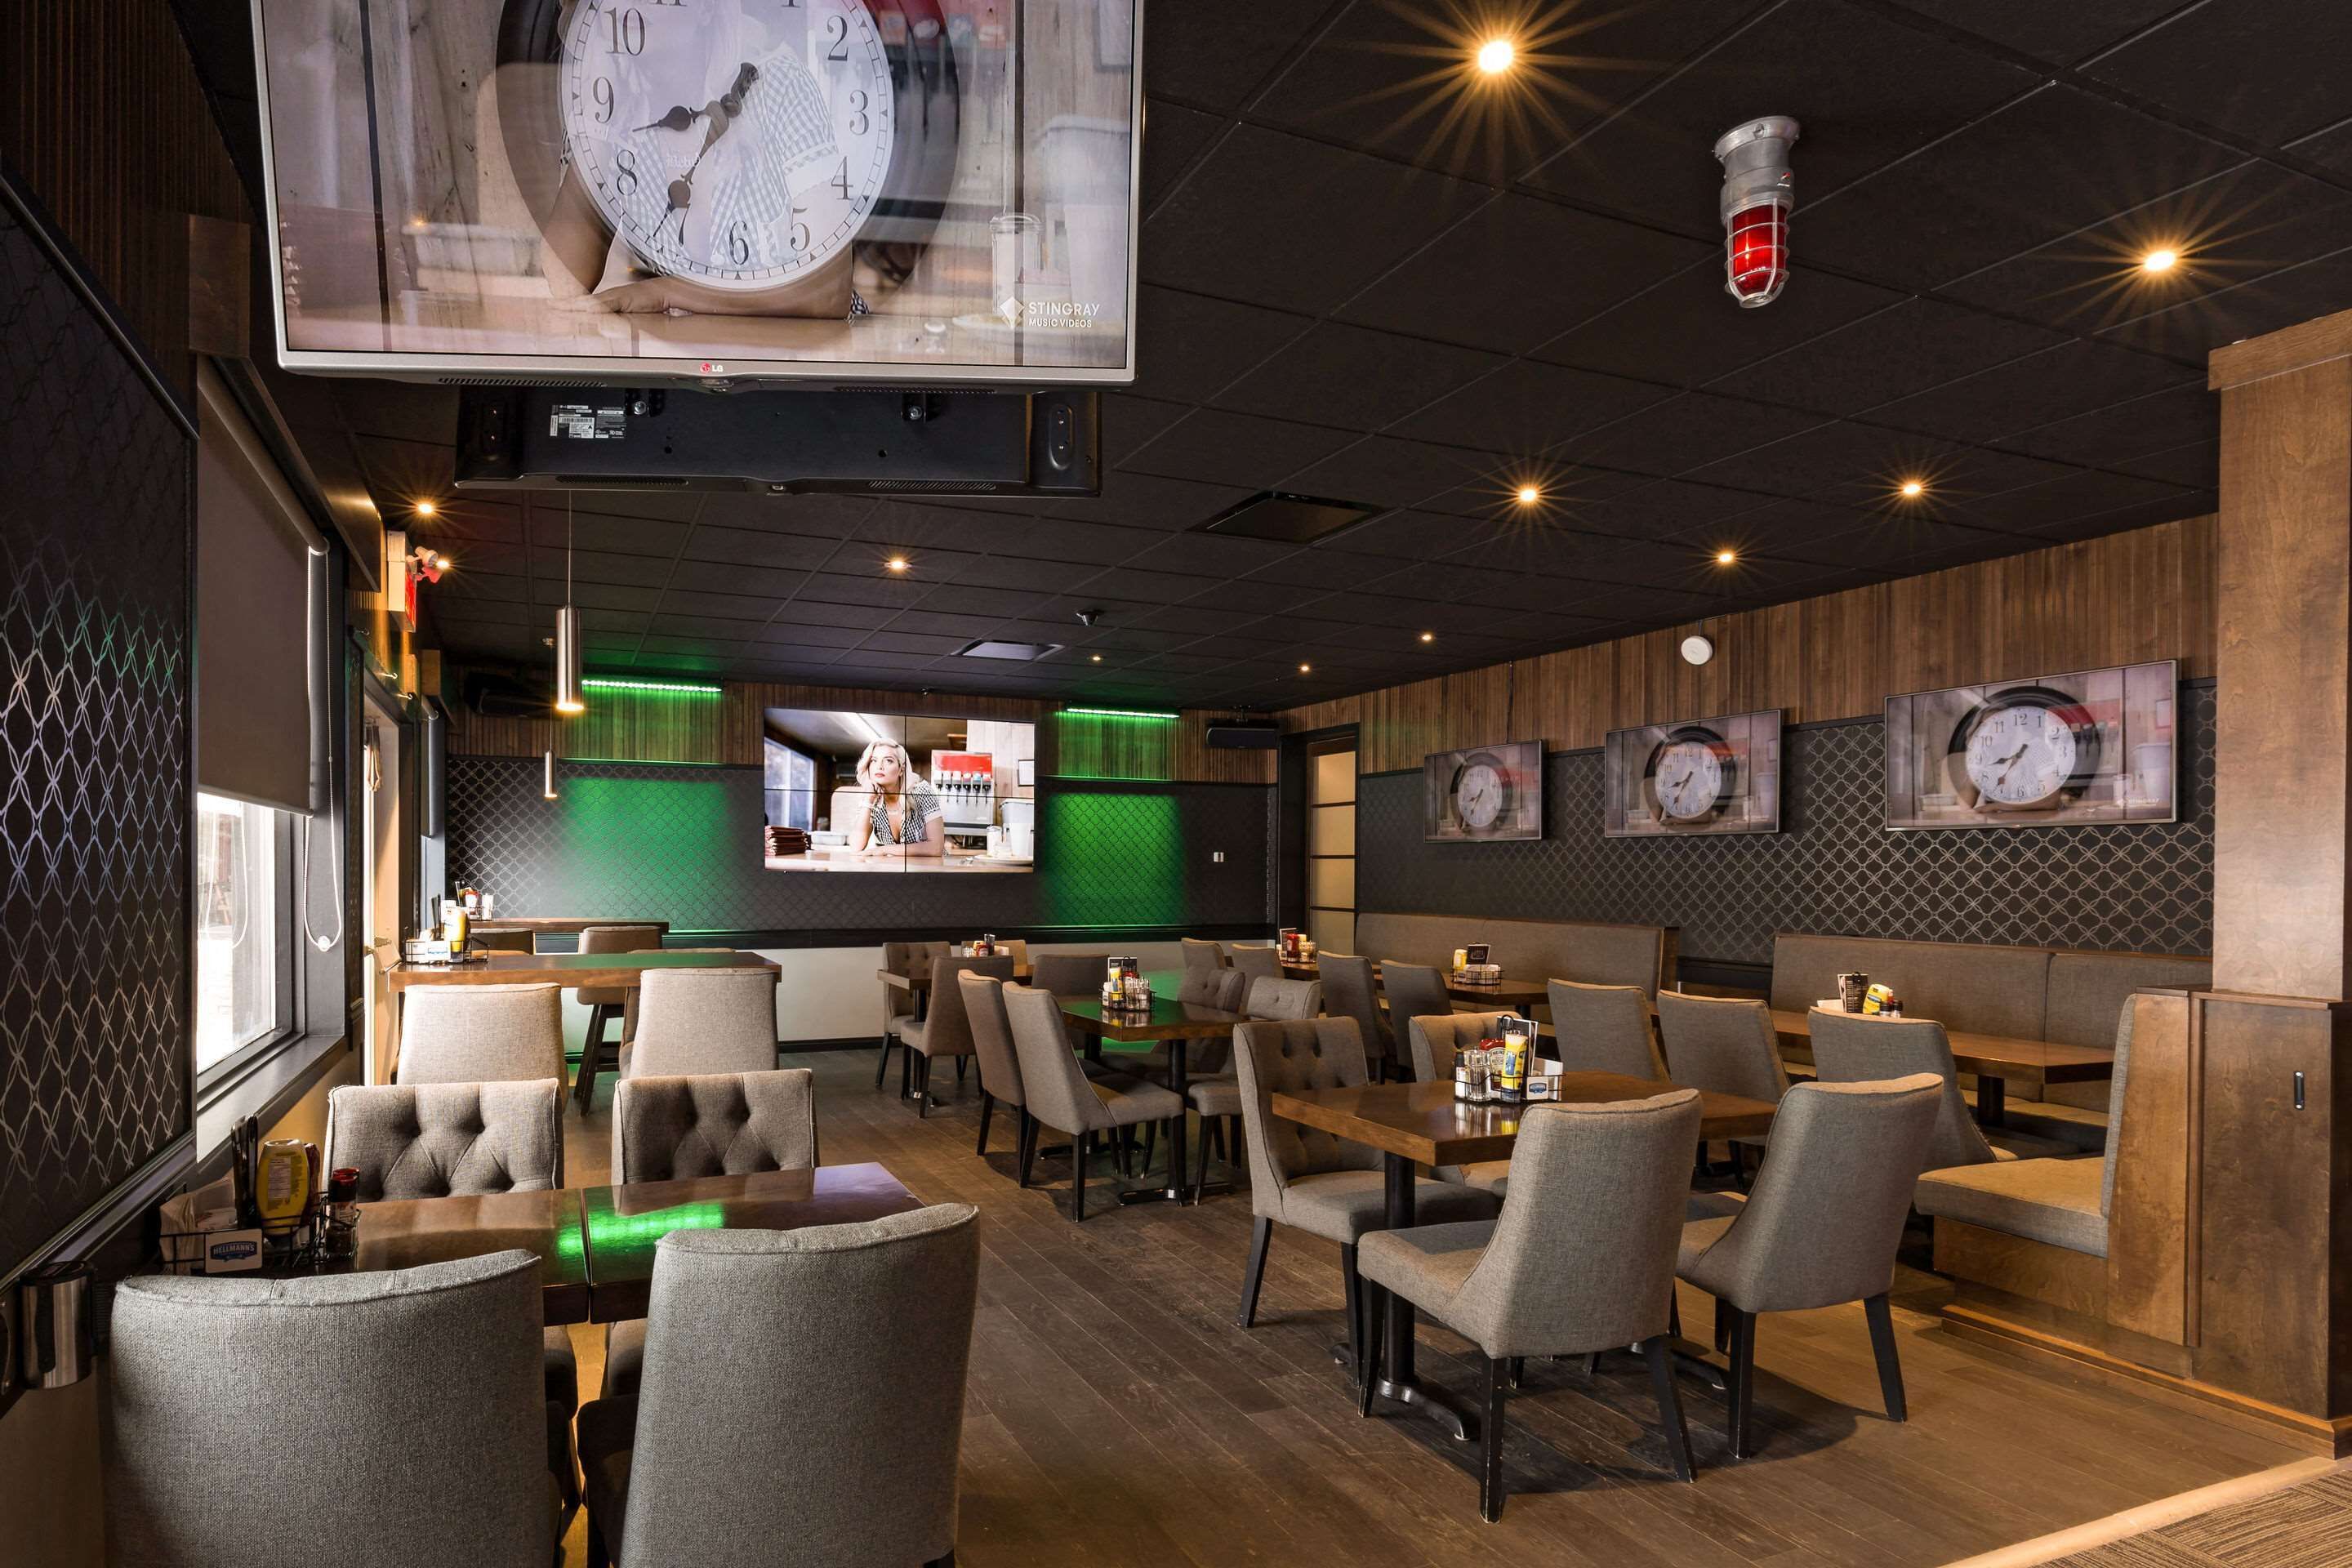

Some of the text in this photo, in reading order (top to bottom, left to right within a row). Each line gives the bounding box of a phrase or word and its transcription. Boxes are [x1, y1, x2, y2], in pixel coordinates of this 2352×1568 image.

[603, 7, 646, 56] 10
[826, 15, 849, 61] 2
[592, 77, 615, 123] 9
[850, 90, 870, 135] 3
[616, 149, 638, 196] 8
[831, 155, 854, 201] 4
[729, 220, 750, 265] 6
[790, 207, 811, 252] 5
[1028, 302, 1100, 316] STINGRAY
[1029, 318, 1092, 327] MUSIC VIDEOS
[711, 364, 724, 372] LG
[1994, 721, 2004, 733] 11
[2014, 714, 2028, 725] 12
[213, 1242, 255, 1255] HELLMANN'S
